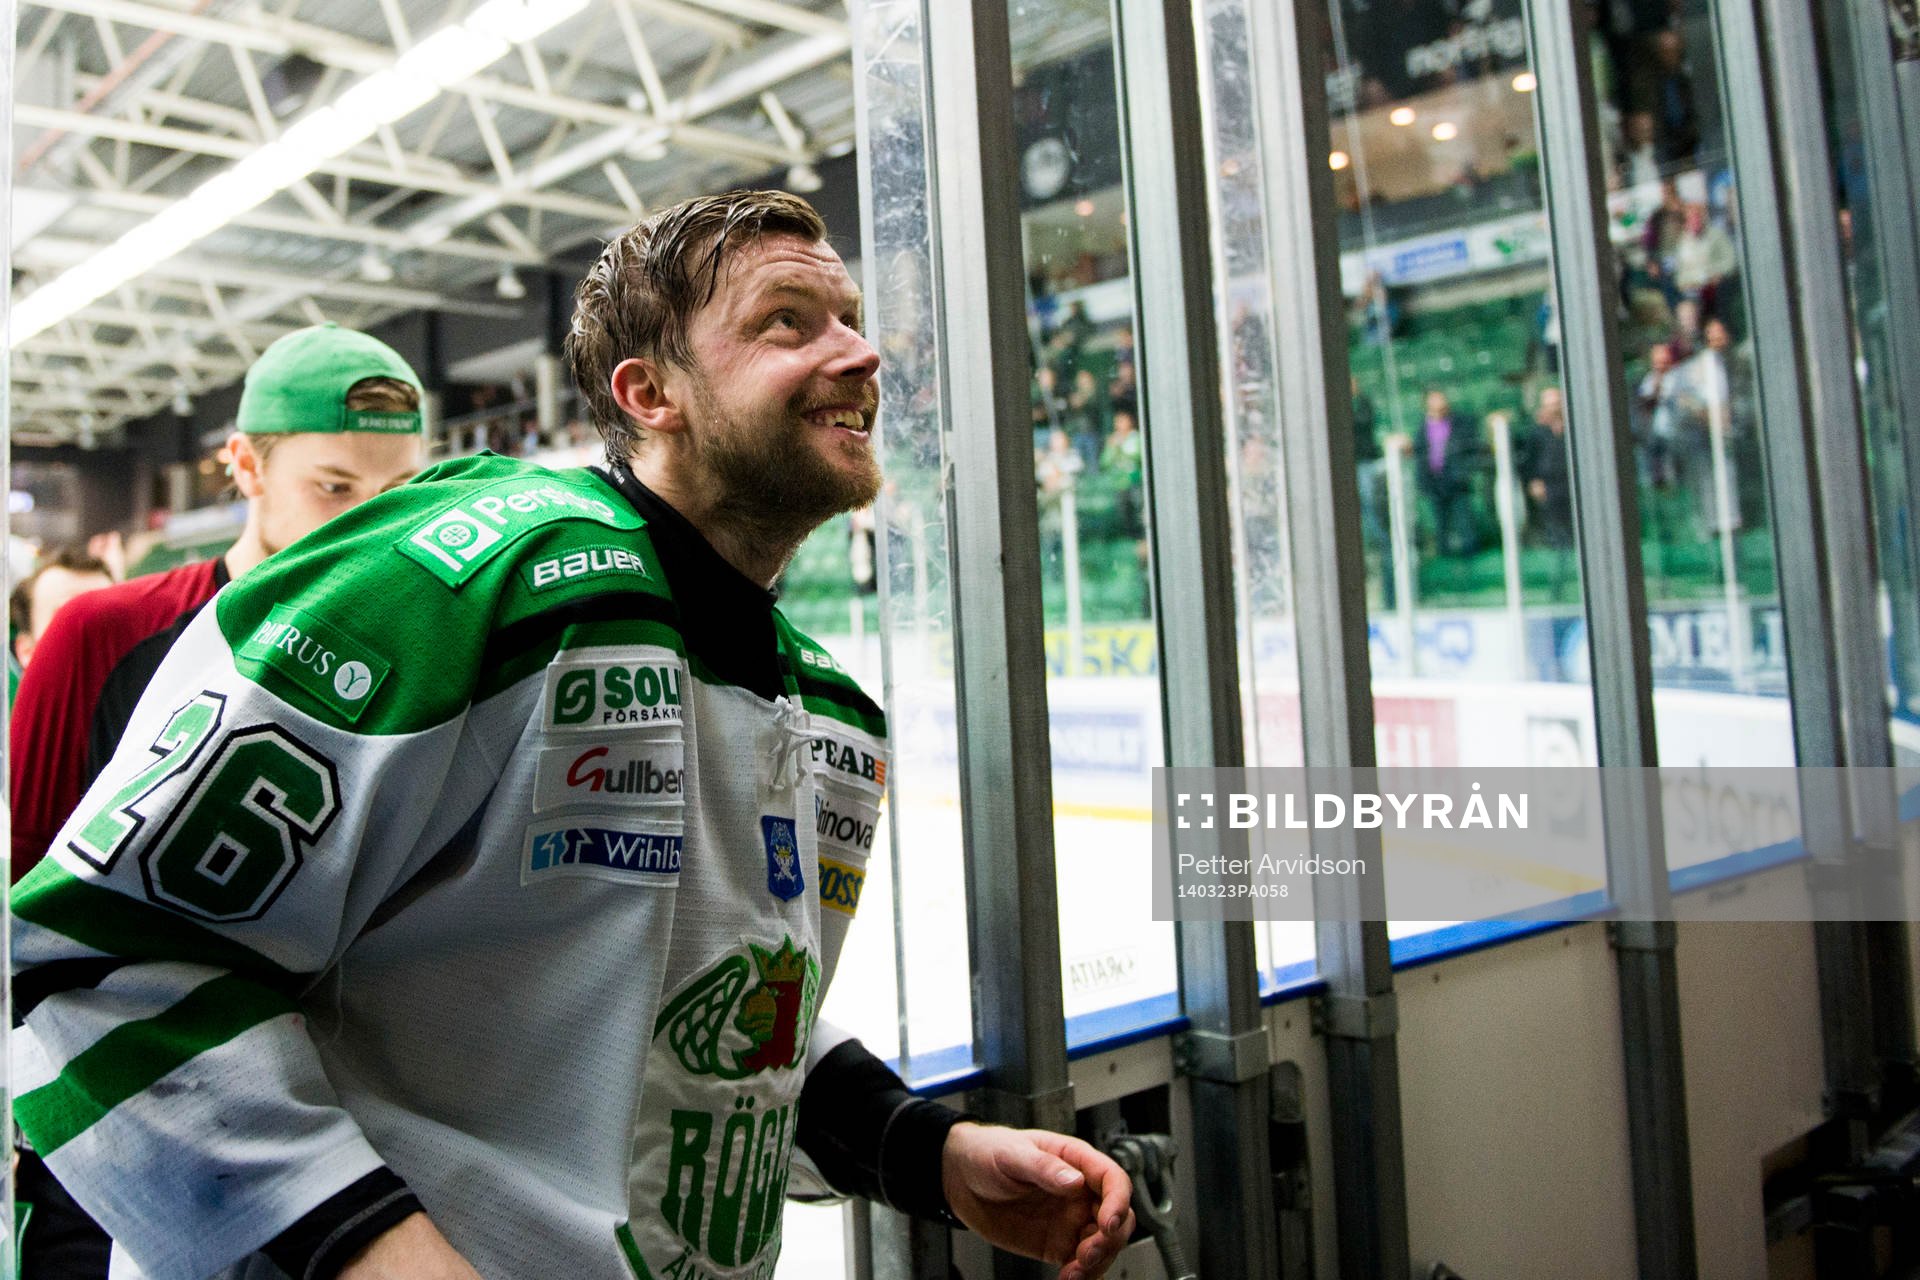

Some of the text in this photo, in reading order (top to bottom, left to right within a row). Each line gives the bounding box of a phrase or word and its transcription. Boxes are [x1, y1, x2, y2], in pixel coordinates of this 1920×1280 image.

[67, 689, 343, 924] 26
[810, 739, 876, 781] PEAB
[661, 1095, 800, 1268] RÖGL
